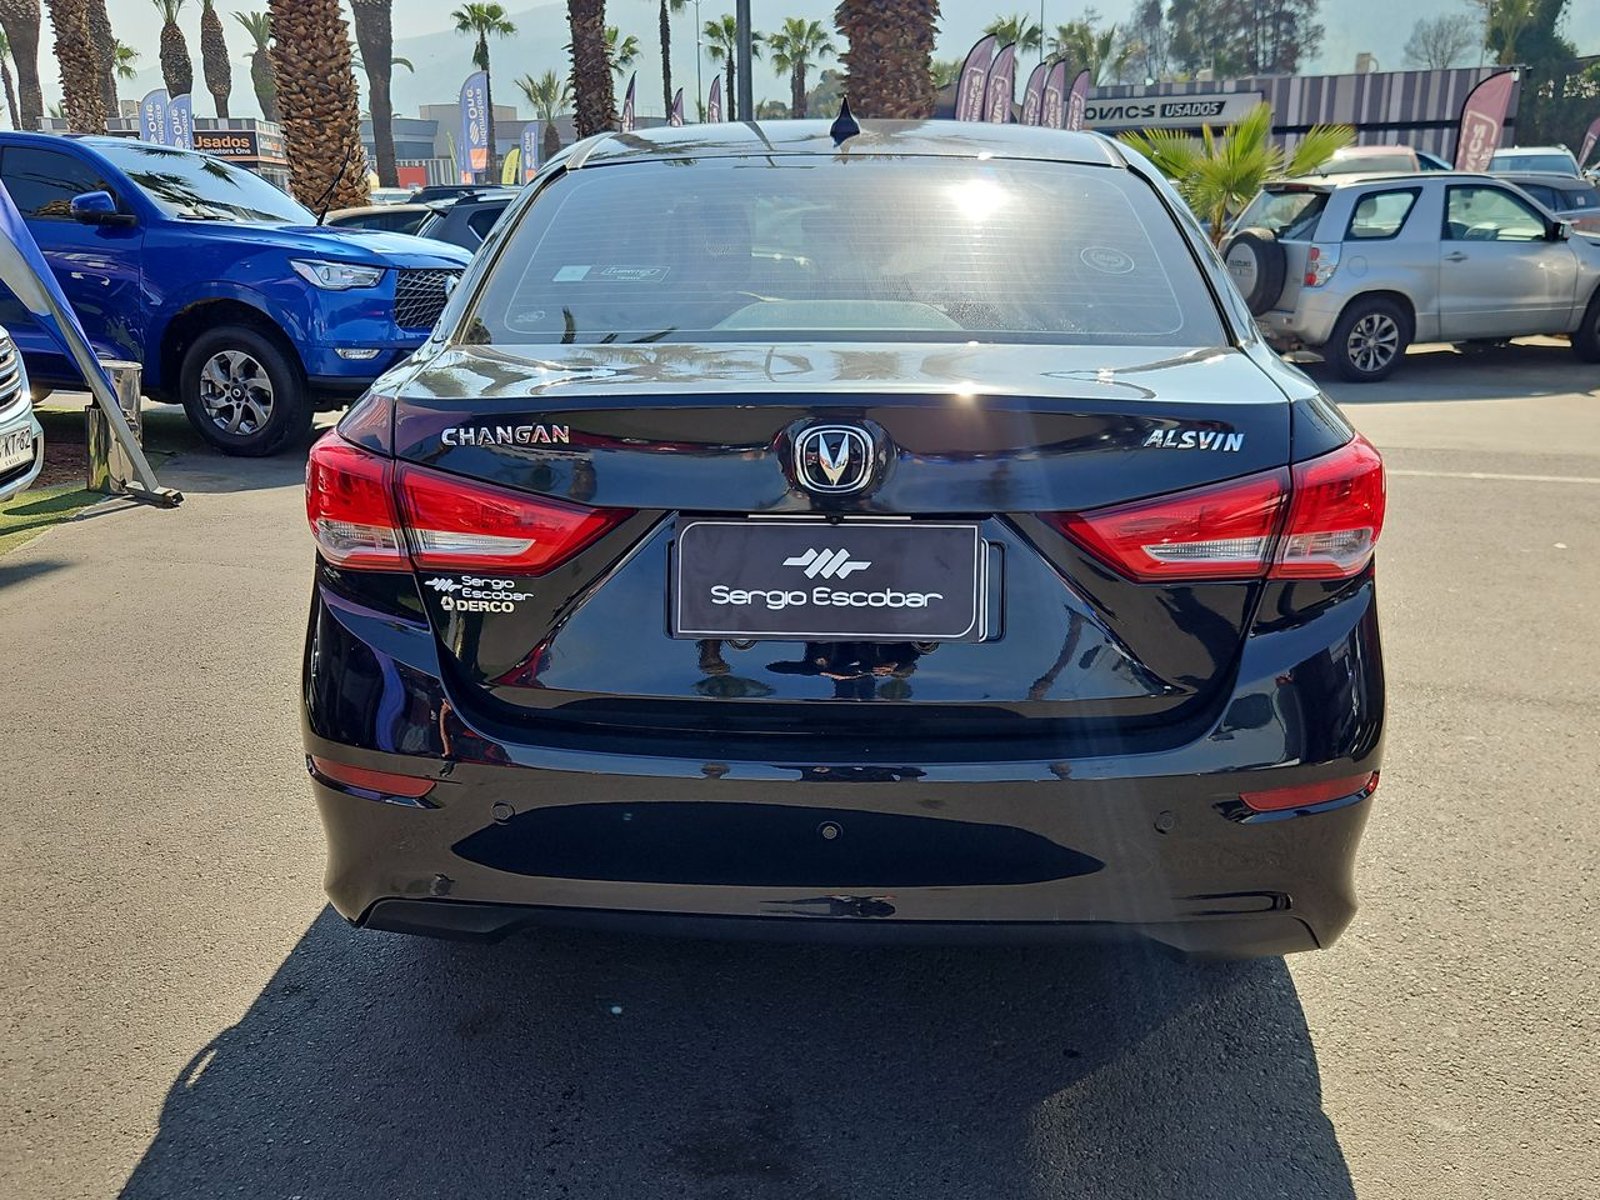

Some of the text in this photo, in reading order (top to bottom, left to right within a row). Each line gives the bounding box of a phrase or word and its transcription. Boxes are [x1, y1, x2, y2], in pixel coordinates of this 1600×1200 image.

[1084, 102, 1220, 120] OVACS USADOS
[440, 424, 570, 446] CHANGAN
[1143, 429, 1244, 452] ALSVIN
[461, 587, 535, 601] Escobar
[710, 585, 944, 610] Sergio Escobar
[456, 600, 515, 613] DERCO
